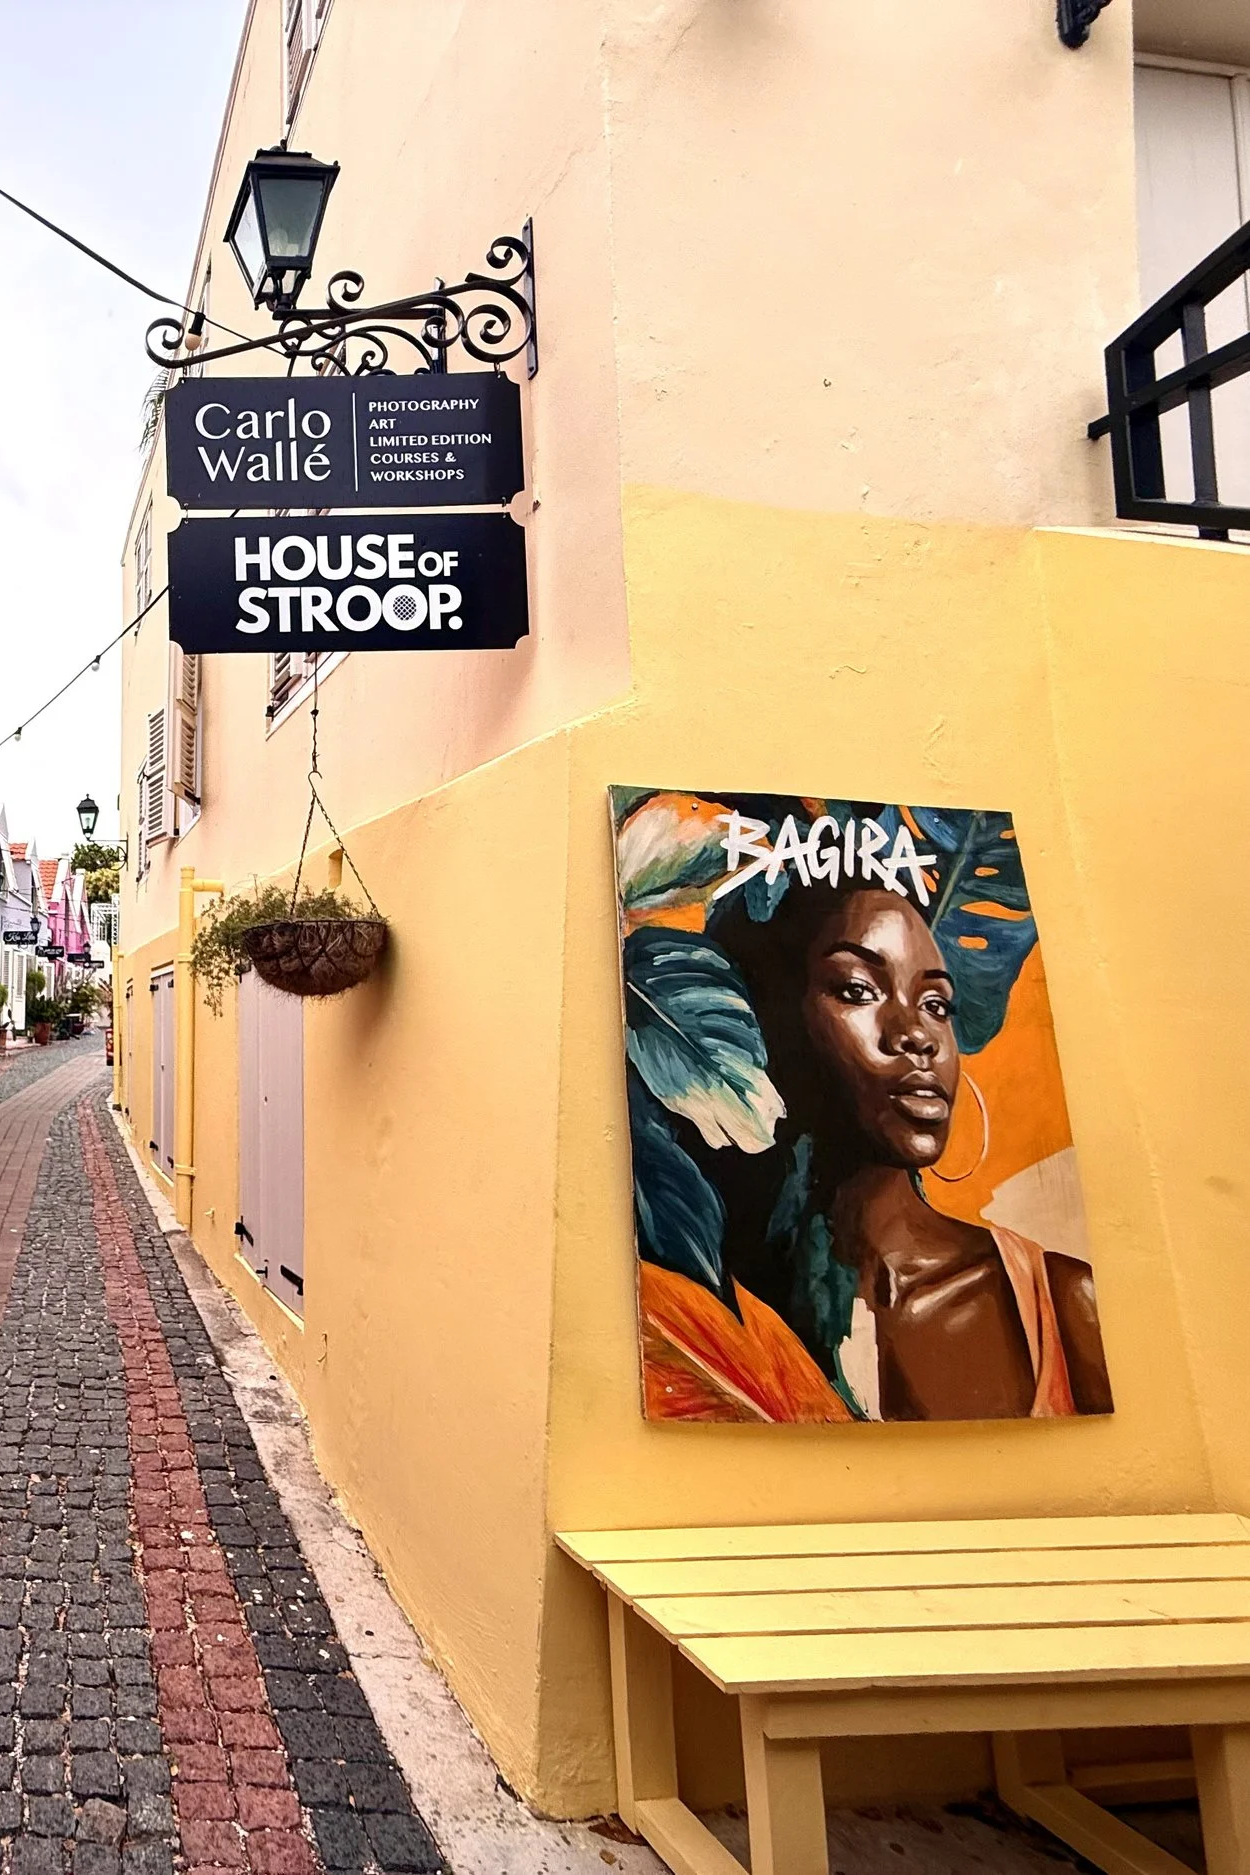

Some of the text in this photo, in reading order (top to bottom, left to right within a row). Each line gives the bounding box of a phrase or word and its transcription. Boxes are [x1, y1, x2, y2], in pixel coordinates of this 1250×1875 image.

[195, 398, 331, 439] Carlo
[368, 398, 480, 413] PHOTOGRAPHY
[368, 418, 397, 430] ART
[369, 433, 492, 447] LIMITED EDITION
[197, 440, 332, 482] Wallé
[370, 451, 457, 465] COURSES &
[370, 468, 465, 482] WORKSHOPS
[234, 533, 459, 581] HOUSE OF
[235, 583, 463, 634] STROOP.
[712, 809, 937, 907] BAGIRA
